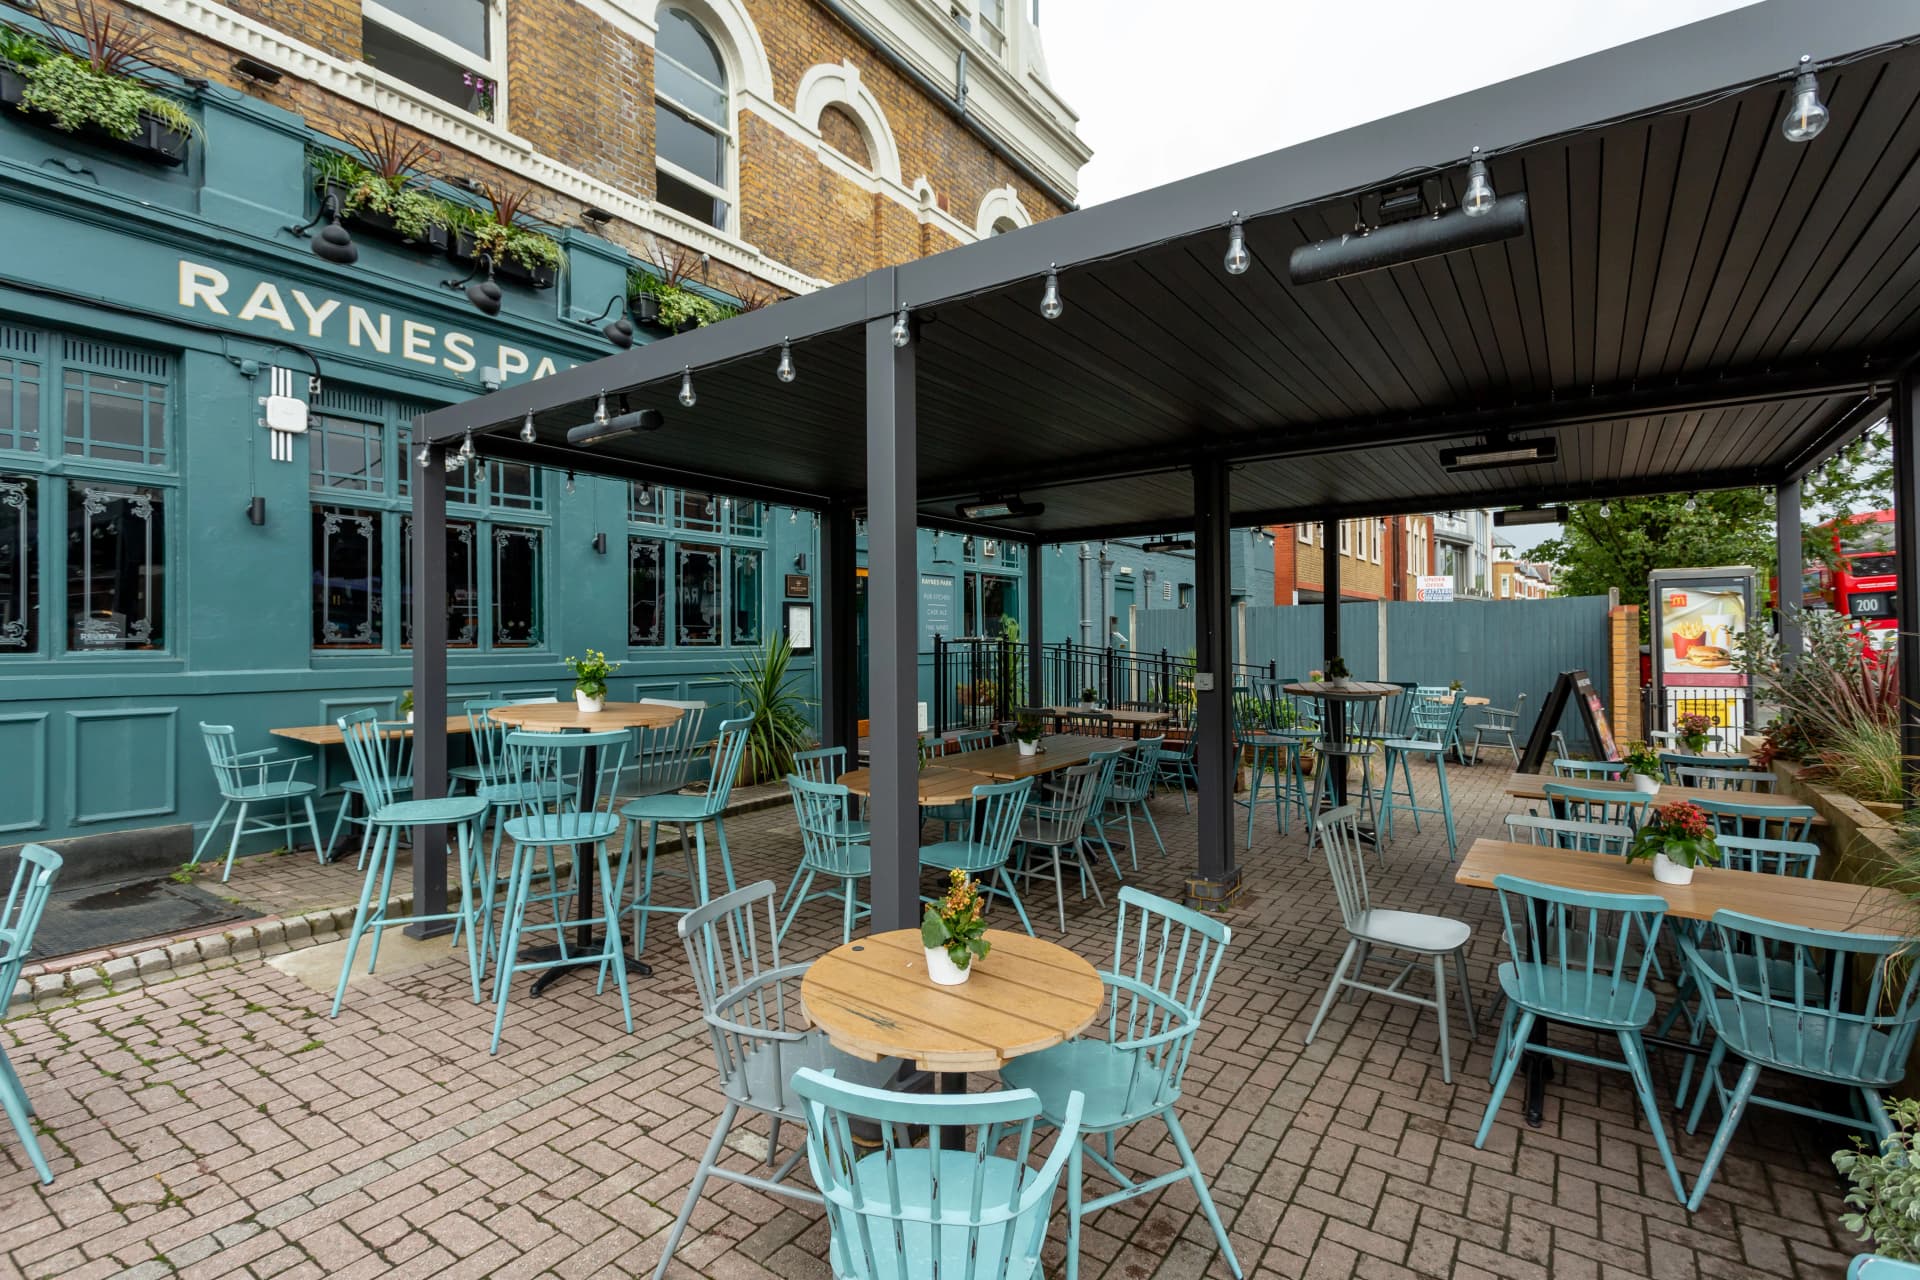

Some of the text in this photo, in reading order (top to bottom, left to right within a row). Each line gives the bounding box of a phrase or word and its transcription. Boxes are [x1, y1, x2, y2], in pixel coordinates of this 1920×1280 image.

[178, 260, 579, 381] RAYNES PA
[1856, 599, 1879, 611] 200
